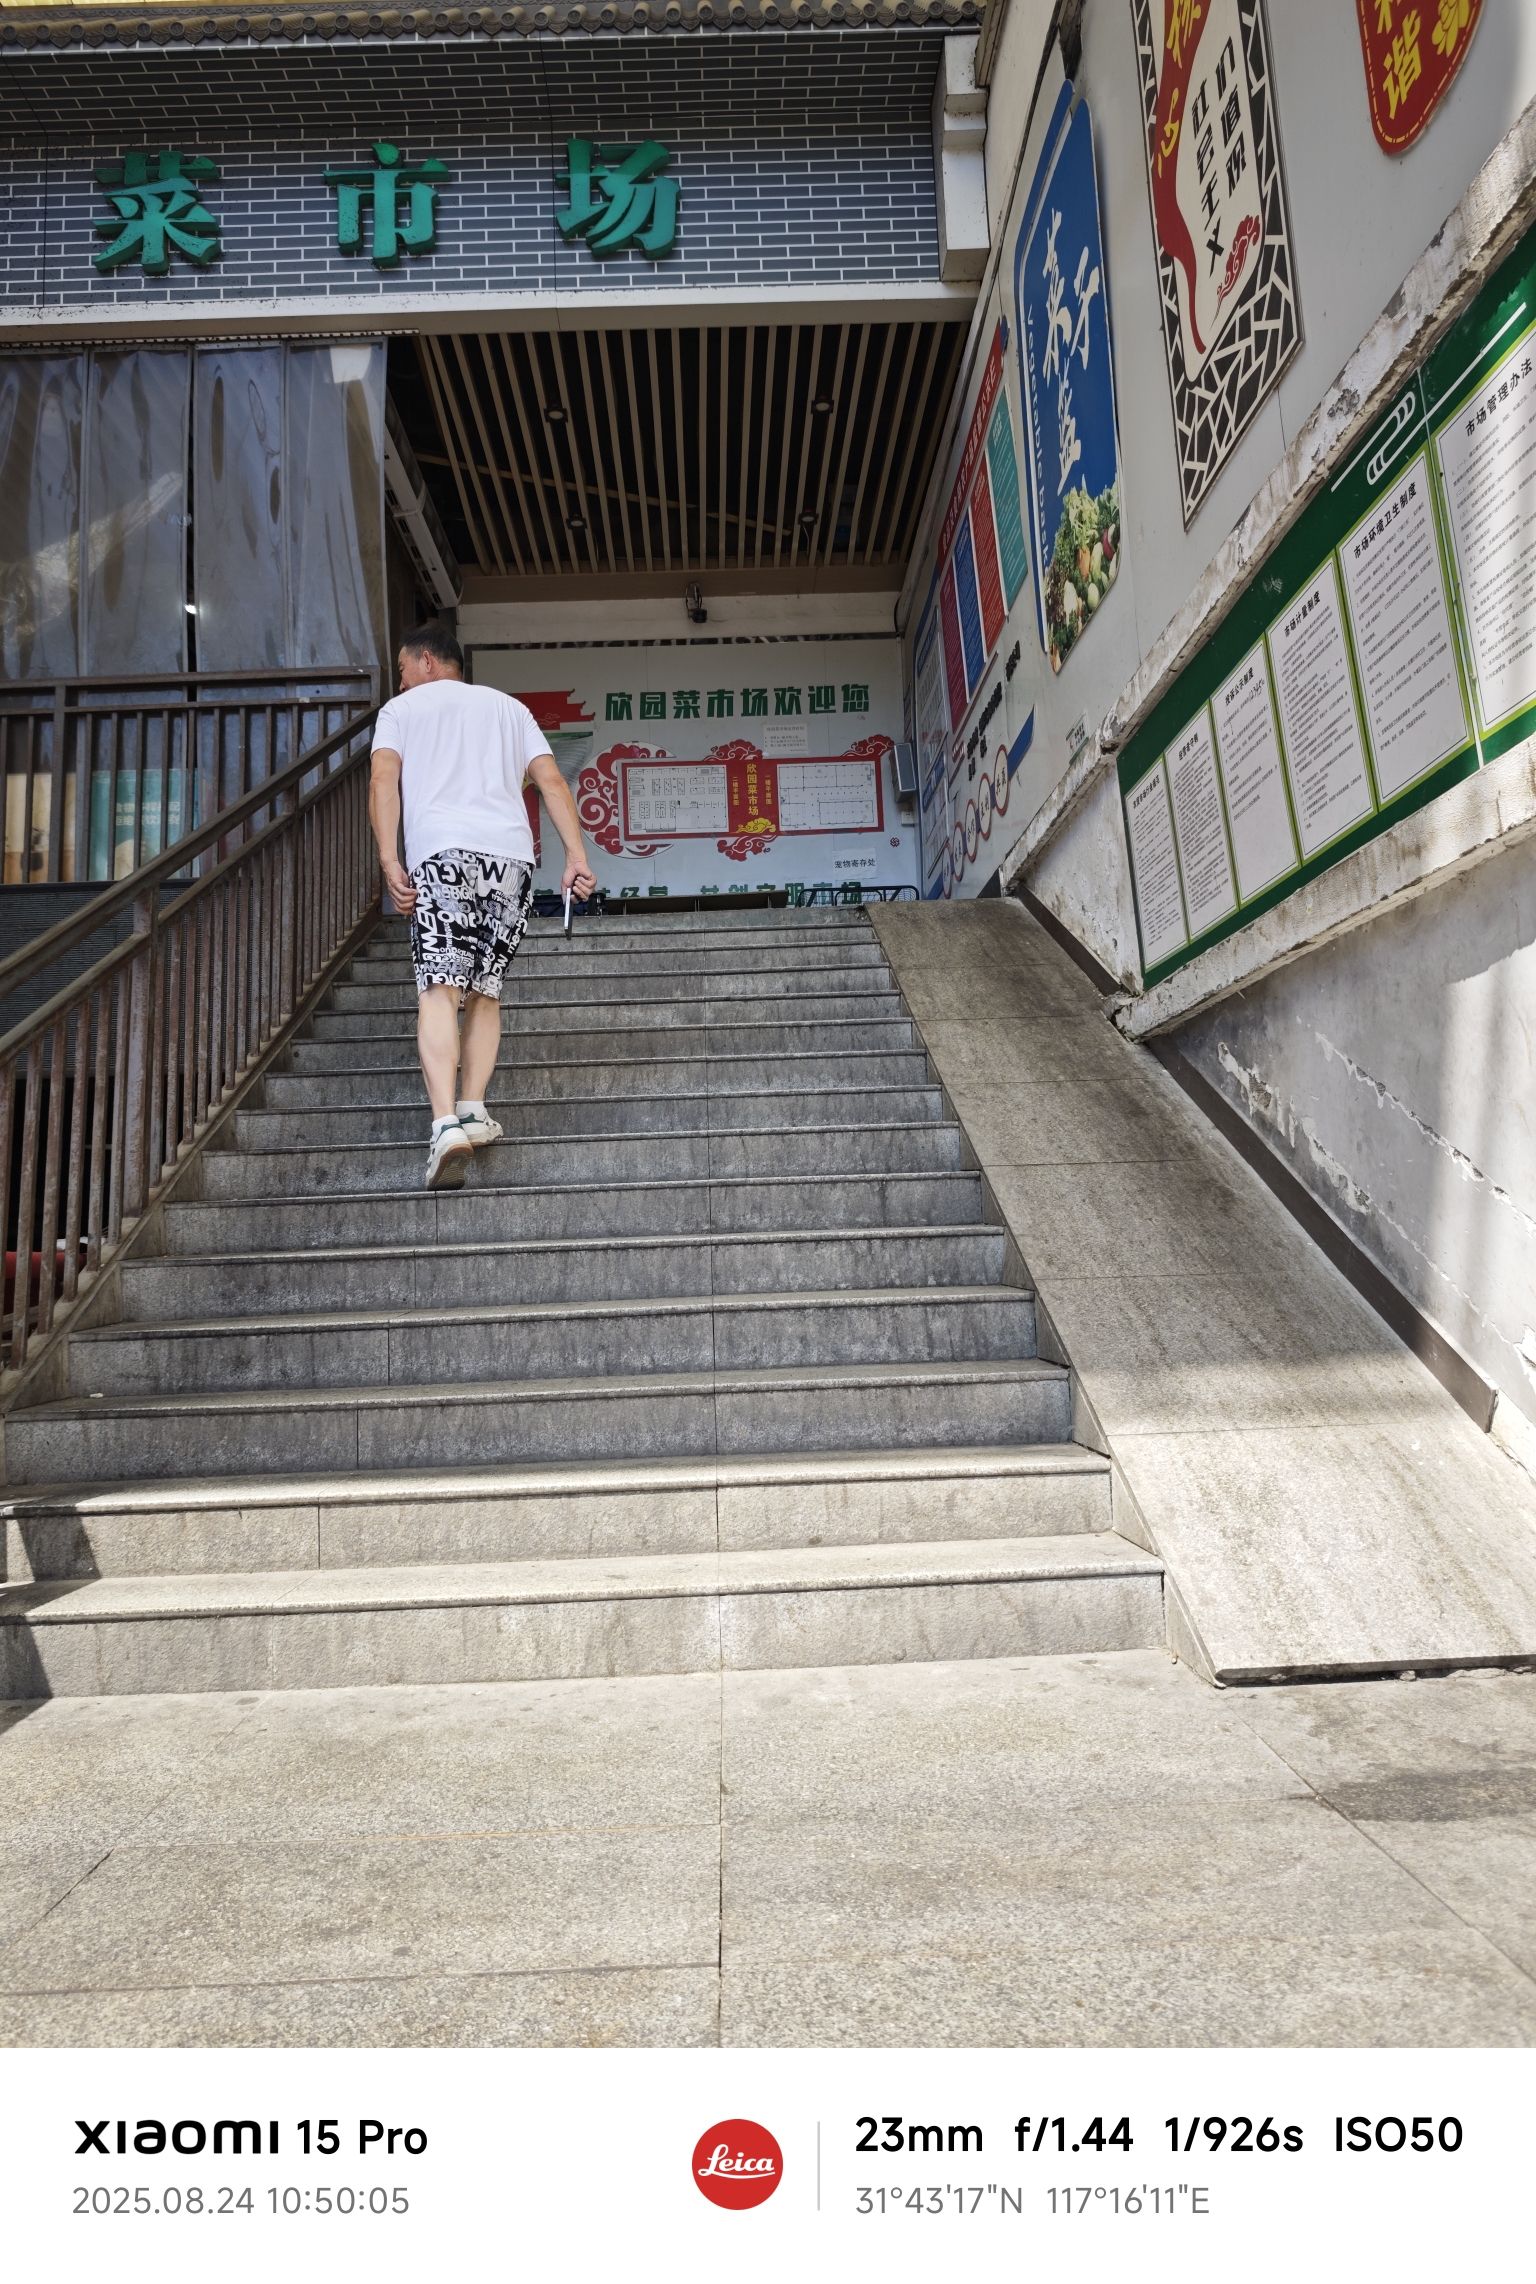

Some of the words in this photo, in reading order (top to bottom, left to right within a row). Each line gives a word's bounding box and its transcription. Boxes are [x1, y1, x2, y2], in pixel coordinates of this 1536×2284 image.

[93, 138, 682, 276] 菜市场
[1192, 78, 1225, 278] 社会主义
[1464, 357, 1533, 438] 市场管理办法
[1353, 481, 1417, 560] 市场环境卫生制度
[604, 684, 870, 722] 欣园菜市场欢迎您
[746, 763, 759, 816] 欣园菜市场
[834, 857, 876, 869] 宠物寄存处
